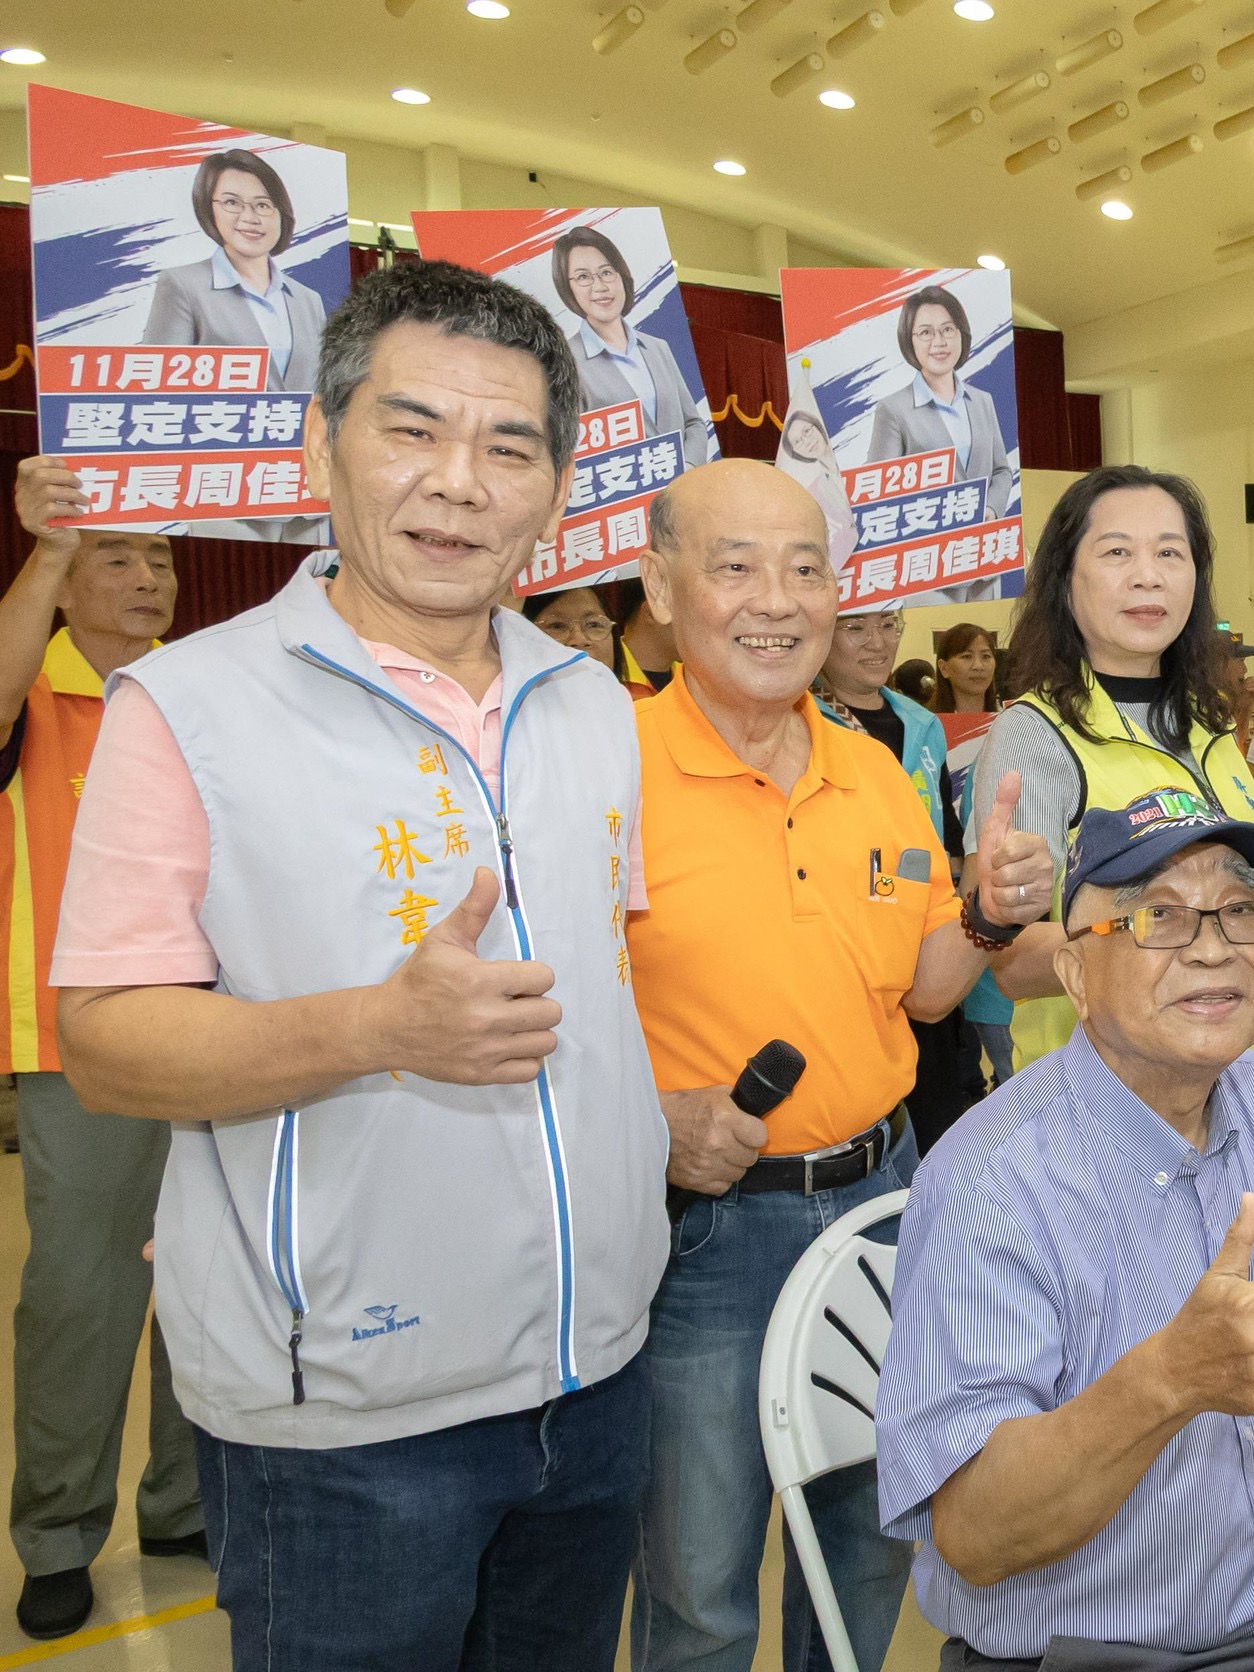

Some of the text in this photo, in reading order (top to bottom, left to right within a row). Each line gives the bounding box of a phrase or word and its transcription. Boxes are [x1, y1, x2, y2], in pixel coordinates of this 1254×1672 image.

[69, 353, 262, 390] 11月28日
[61, 401, 303, 448] 堅定支持
[75, 461, 315, 515] 市長周佳
[855, 486, 980, 546] 定支持
[417, 743, 470, 859] 副主席
[1128, 806, 1164, 826] 2021
[604, 805, 631, 988] 市民代表
